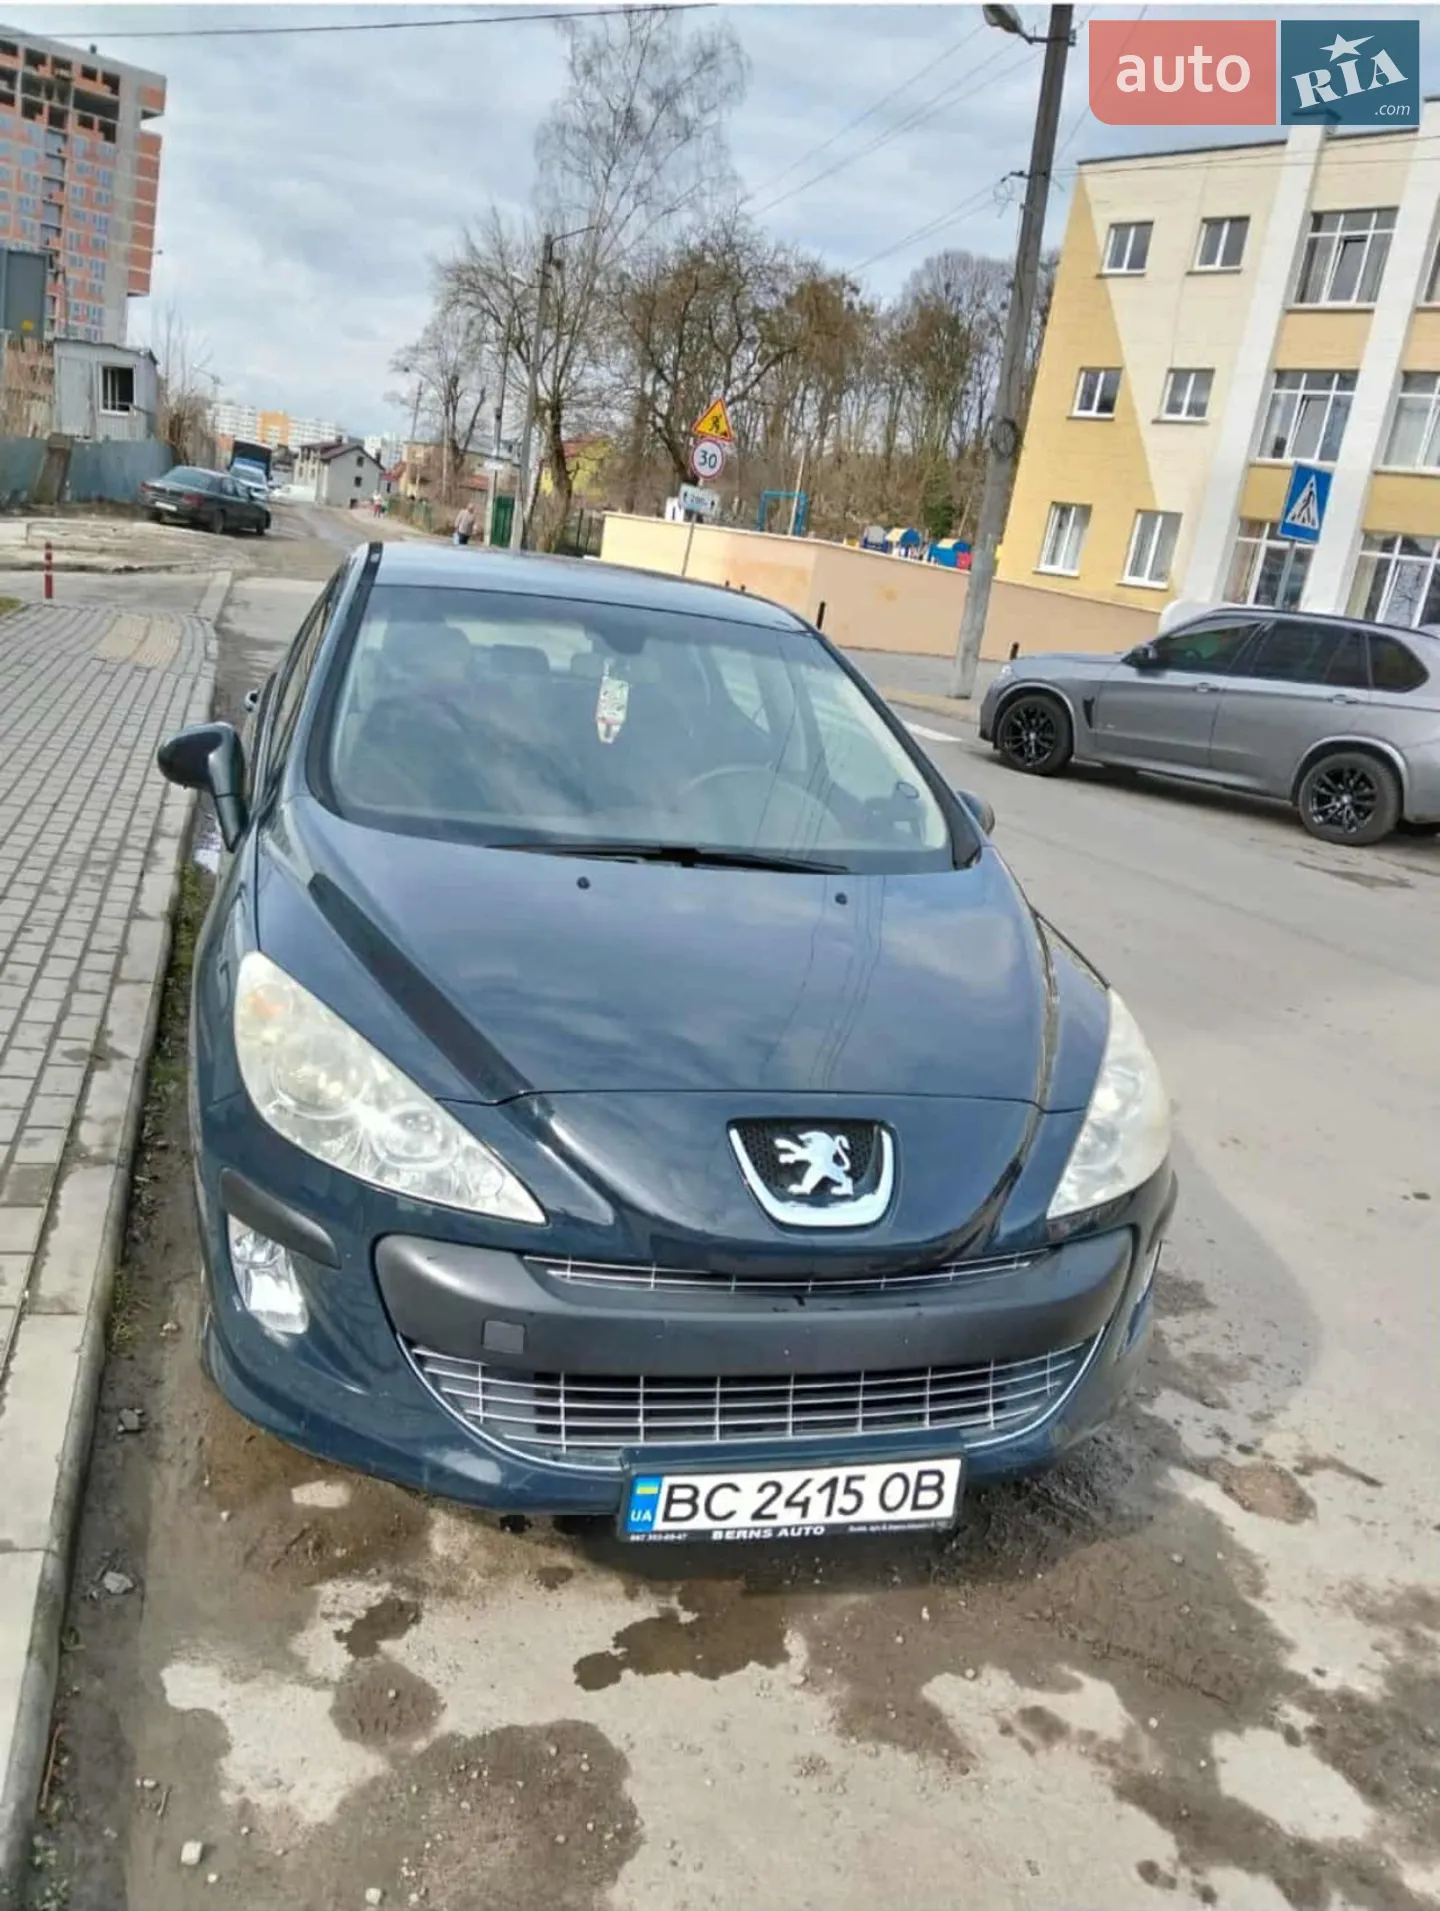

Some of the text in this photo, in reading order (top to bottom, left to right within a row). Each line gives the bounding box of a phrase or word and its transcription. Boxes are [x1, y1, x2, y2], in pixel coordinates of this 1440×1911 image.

[699, 450, 718, 469] 30
[661, 1469, 946, 1523] BC 2415 OB
[630, 1510, 652, 1523] UA
[711, 1525, 826, 1541] BERNS AUTO
